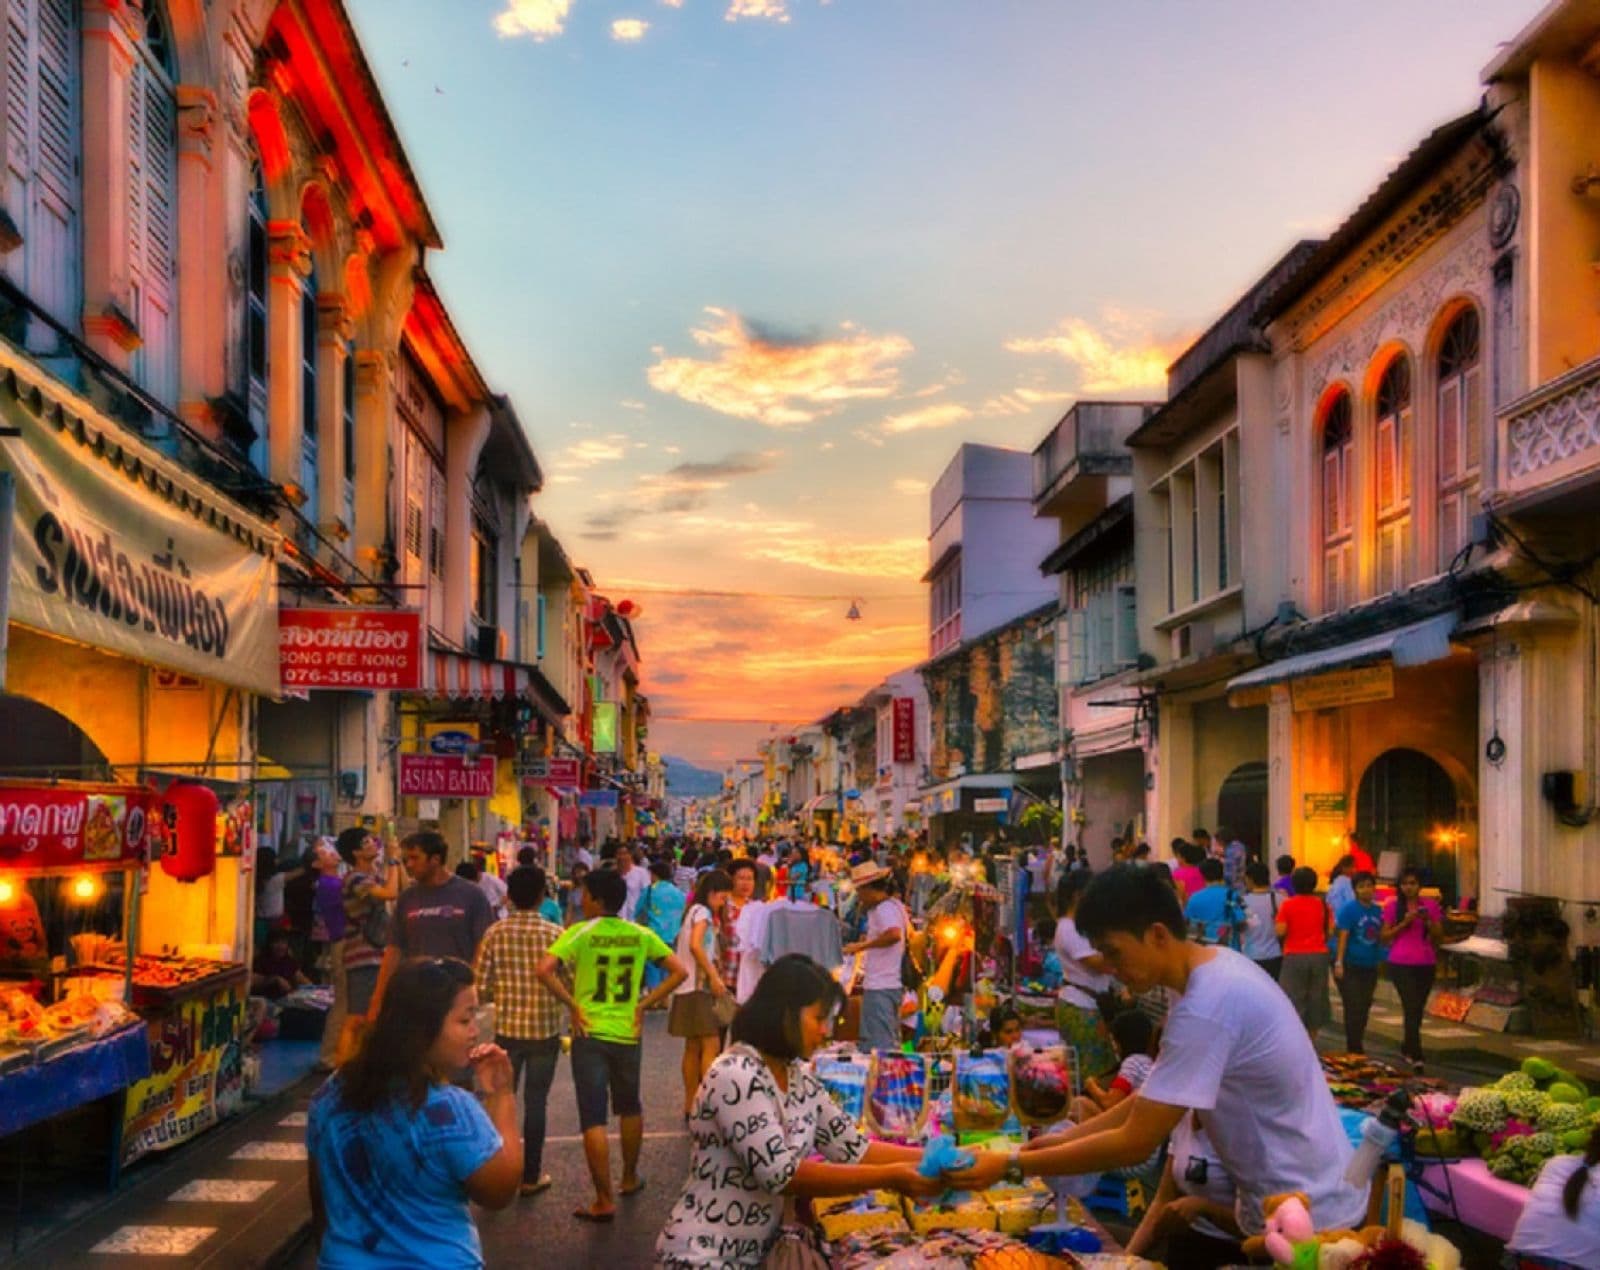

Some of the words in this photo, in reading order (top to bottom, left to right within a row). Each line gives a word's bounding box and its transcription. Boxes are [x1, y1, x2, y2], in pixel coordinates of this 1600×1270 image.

[326, 652, 357, 666] PEE
[361, 654, 408, 668] NONG
[402, 767, 445, 791] ASIAN
[448, 768, 491, 793] BATIK
[592, 956, 634, 1003] 13
